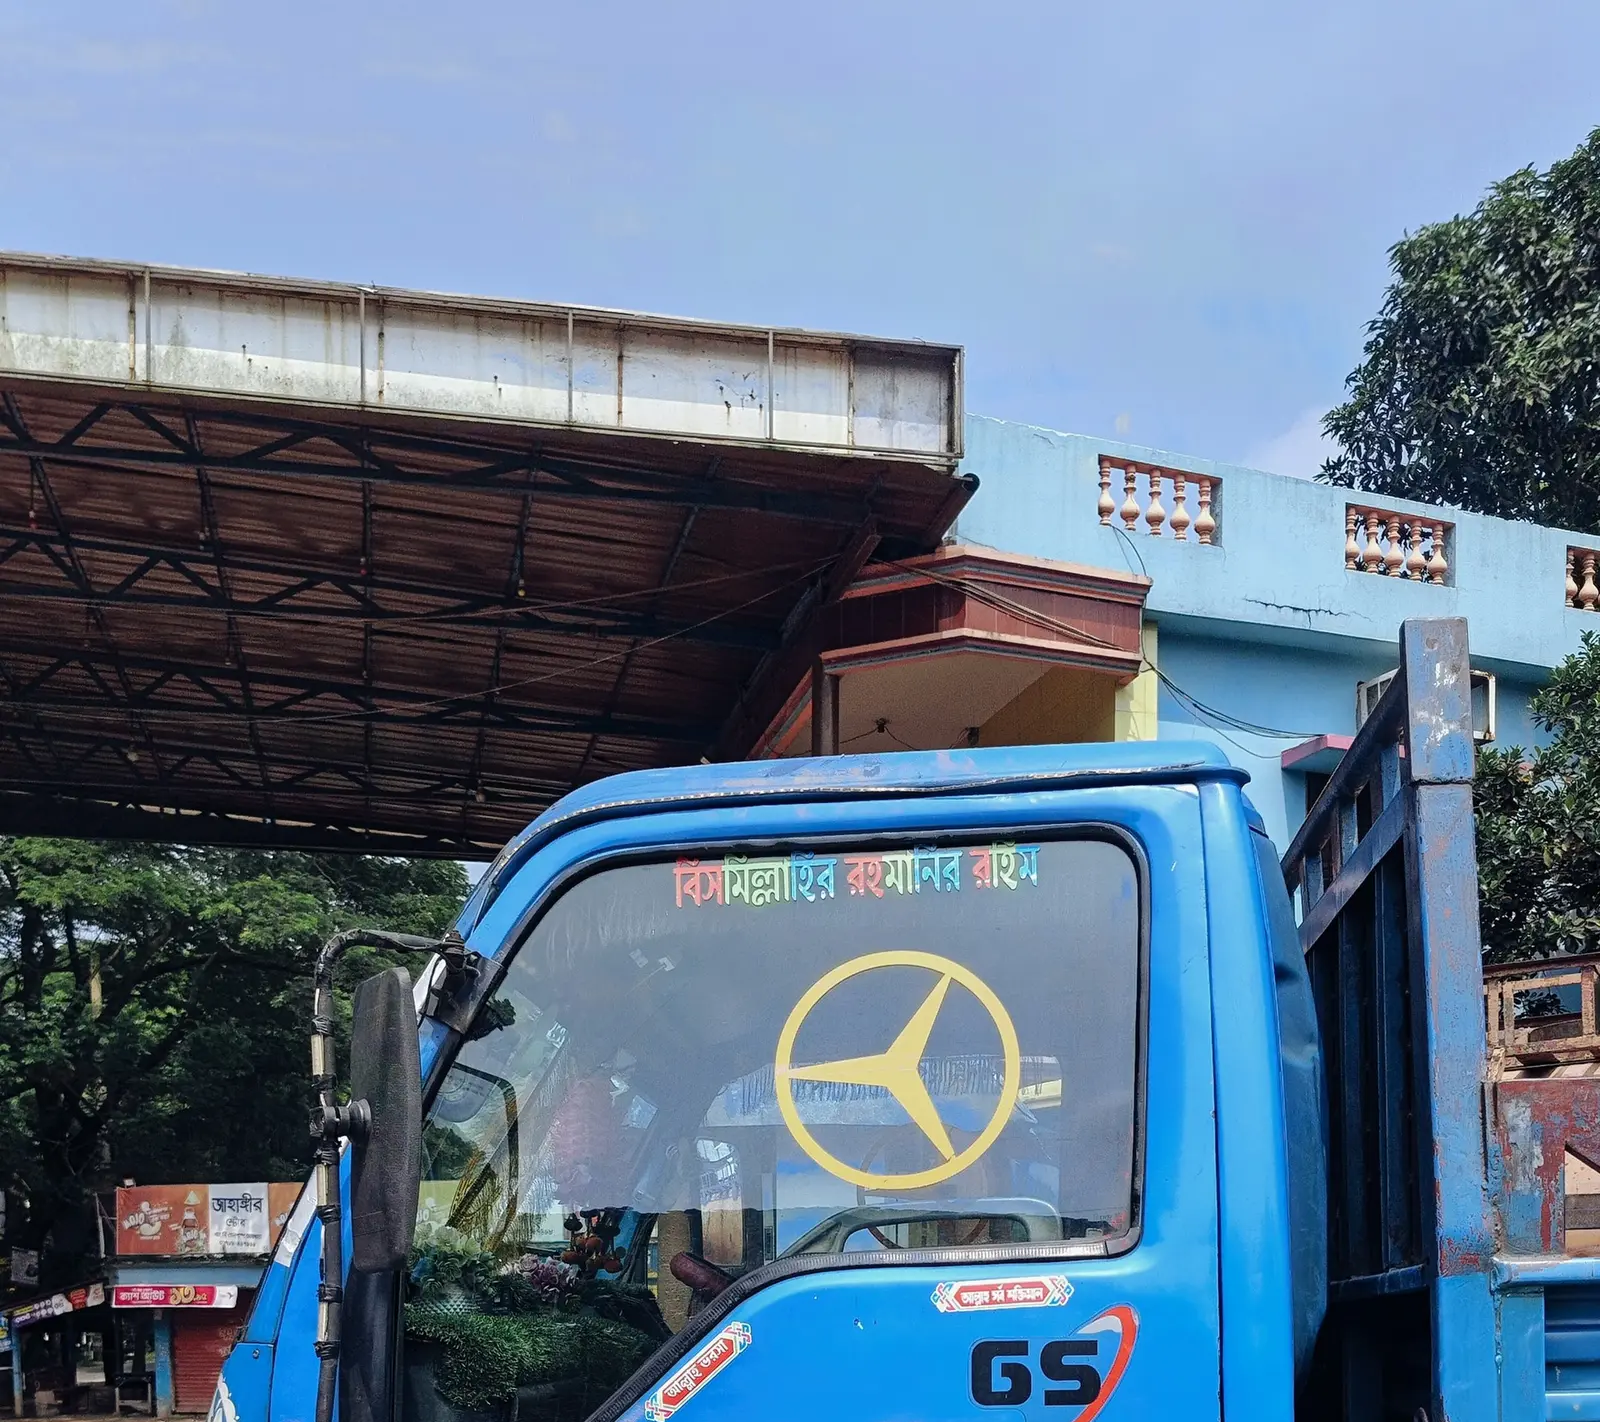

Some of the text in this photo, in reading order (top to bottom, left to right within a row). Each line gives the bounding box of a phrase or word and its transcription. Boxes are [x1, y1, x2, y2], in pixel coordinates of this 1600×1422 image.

[673, 849, 838, 908] বিসমিল্লাহির
[844, 843, 964, 898] রহমানির
[212, 1192, 264, 1213] জাহাঙ্গীর
[663, 1339, 729, 1397] আল্লাহ ভরসা
[971, 1339, 1102, 1406] GS
